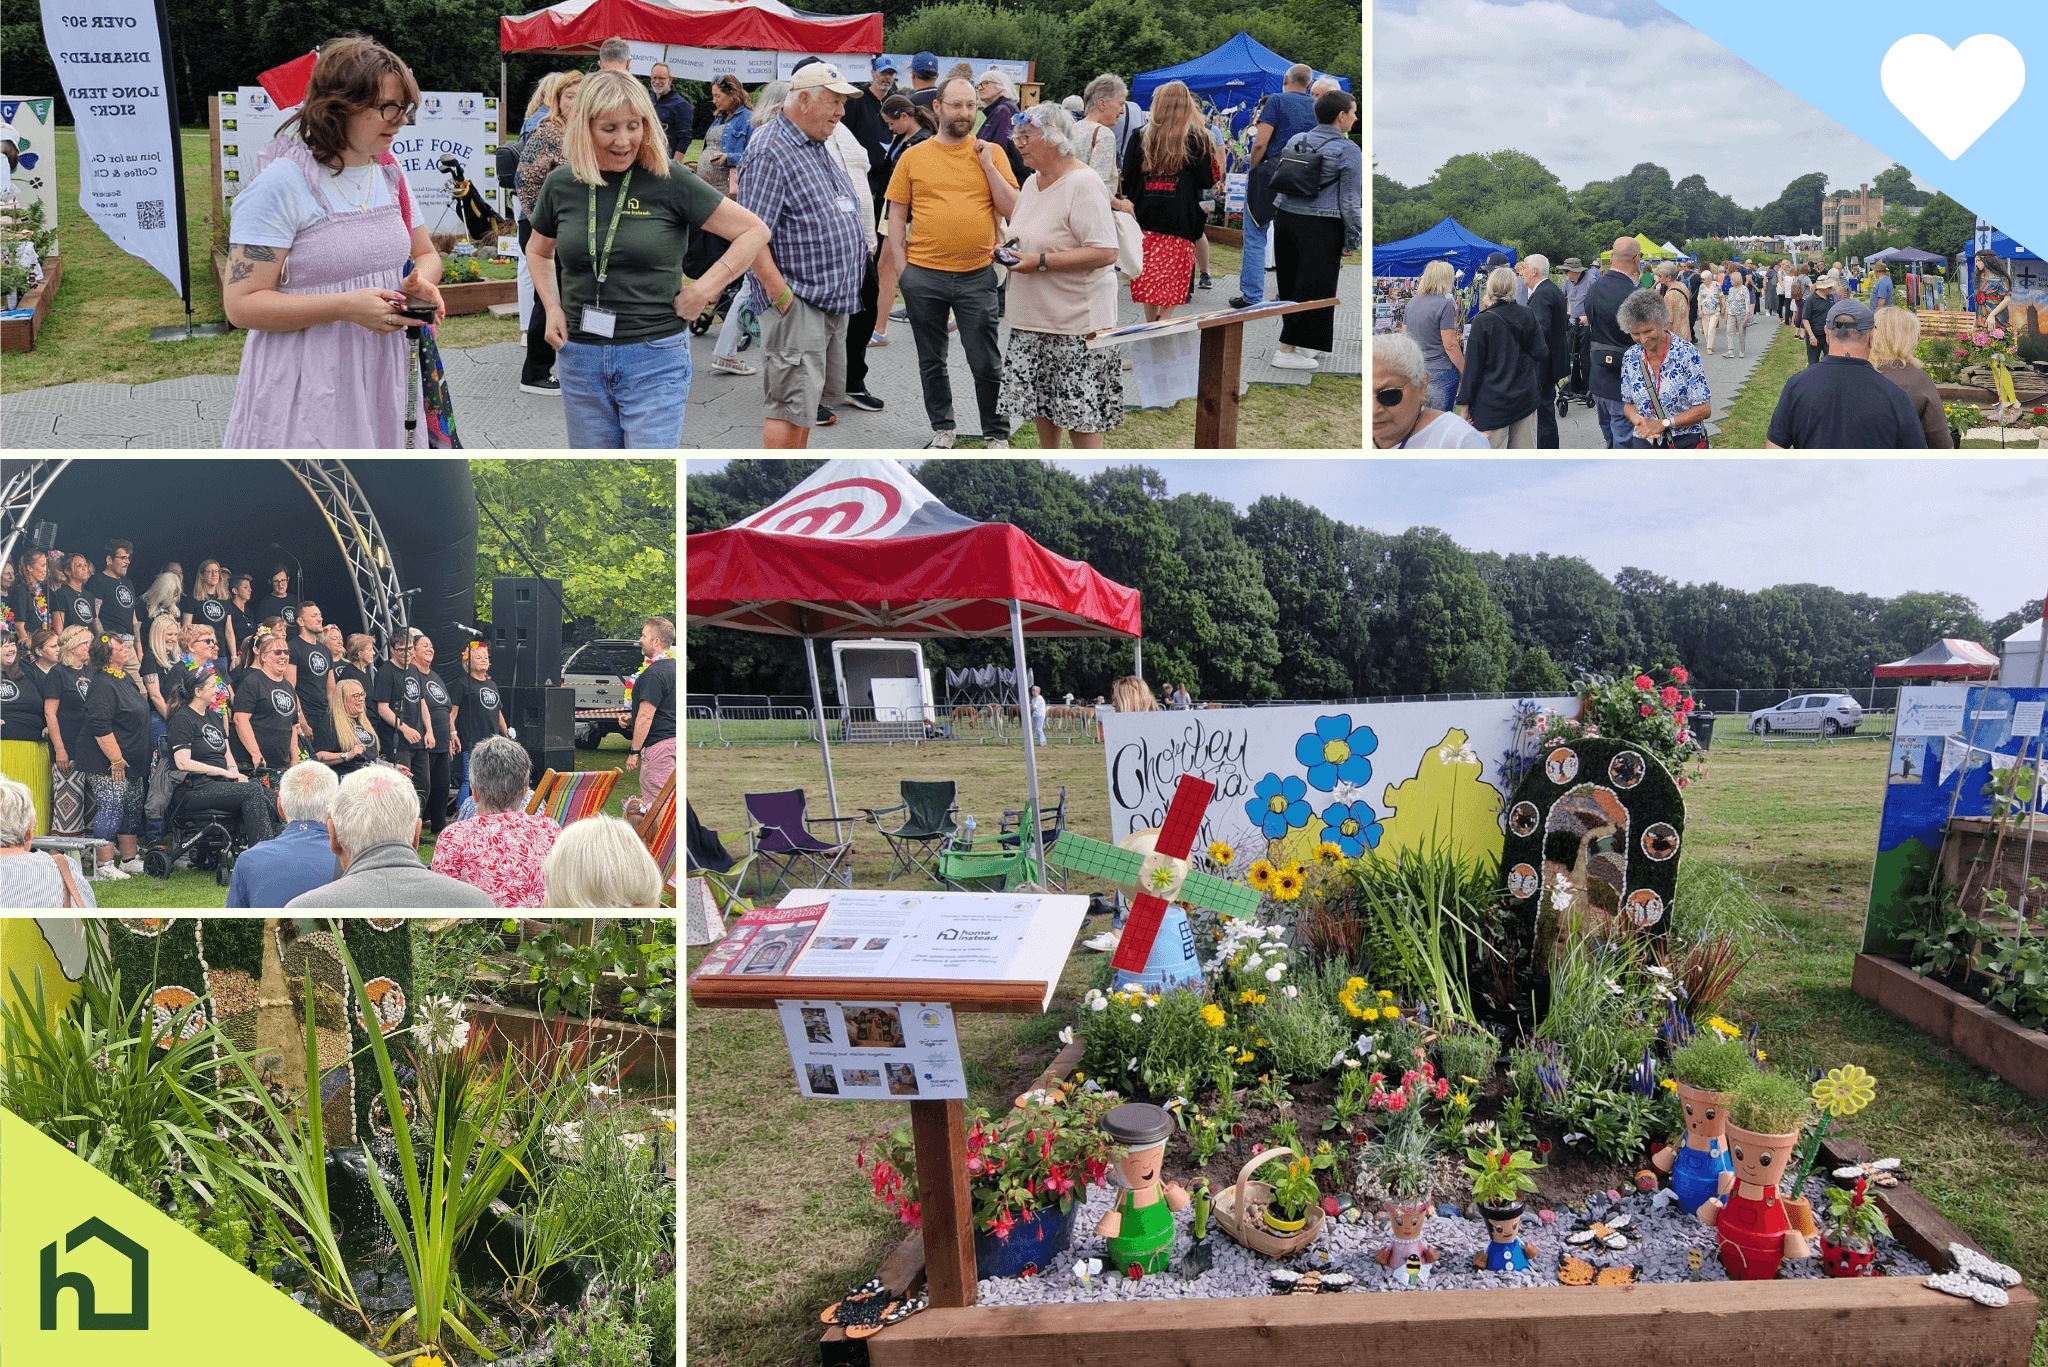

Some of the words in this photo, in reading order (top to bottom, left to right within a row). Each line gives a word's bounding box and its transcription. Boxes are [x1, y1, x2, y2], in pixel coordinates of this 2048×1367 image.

[669, 57, 704, 68] LONELINESS
[392, 138, 424, 155] OLF
[431, 138, 474, 160] FORE
[400, 158, 421, 172] HE
[1112, 718, 1254, 810] Chorley
